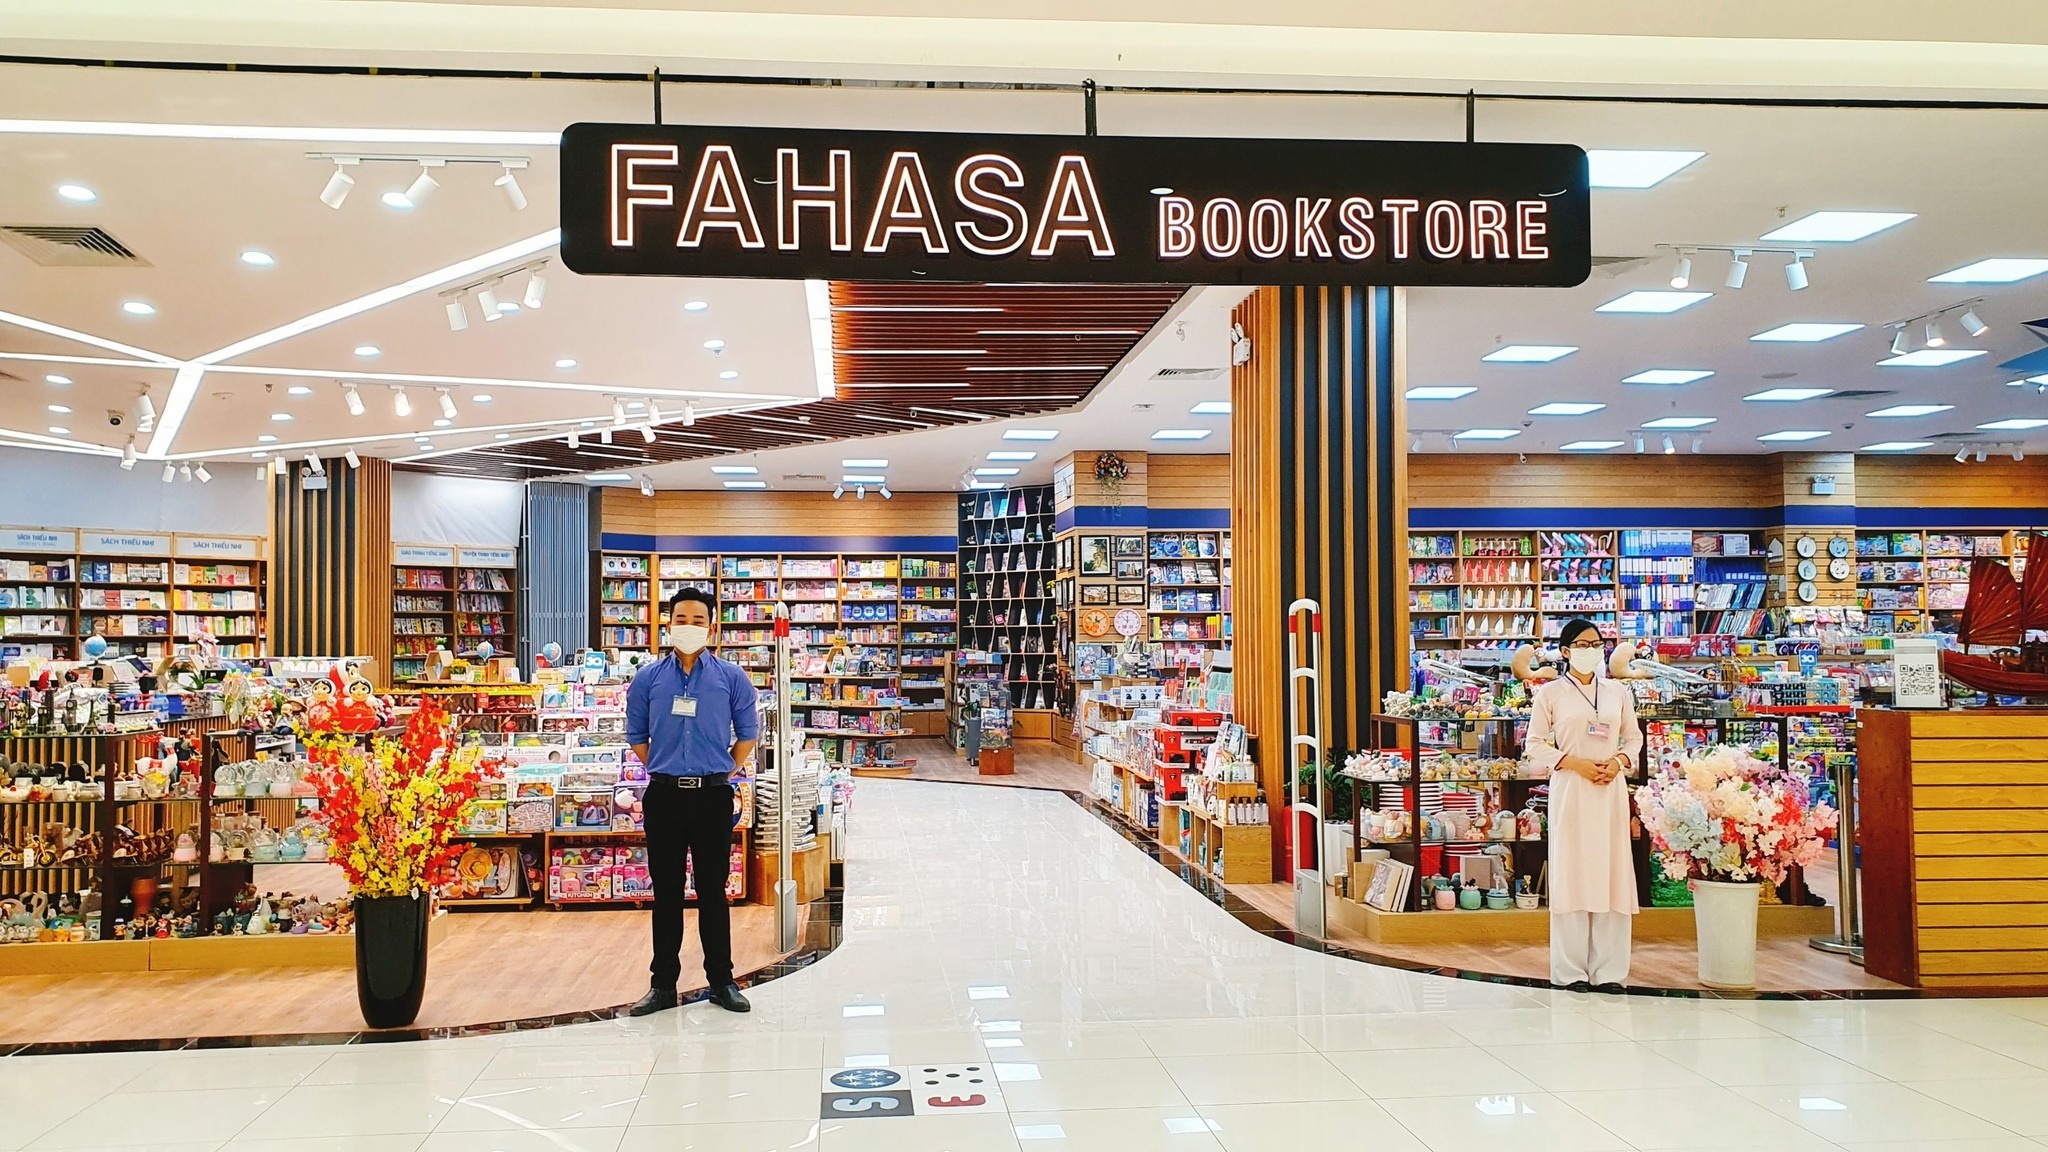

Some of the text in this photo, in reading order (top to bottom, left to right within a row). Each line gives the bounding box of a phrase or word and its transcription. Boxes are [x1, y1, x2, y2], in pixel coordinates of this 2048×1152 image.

[611, 144, 1550, 260] FAHASA BOOKSTORE
[100, 537, 119, 545] SÁCH
[192, 541, 210, 549] SÁCH
[1801, 654, 1815, 663] 30
[739, 788, 751, 826] KITCHEN
